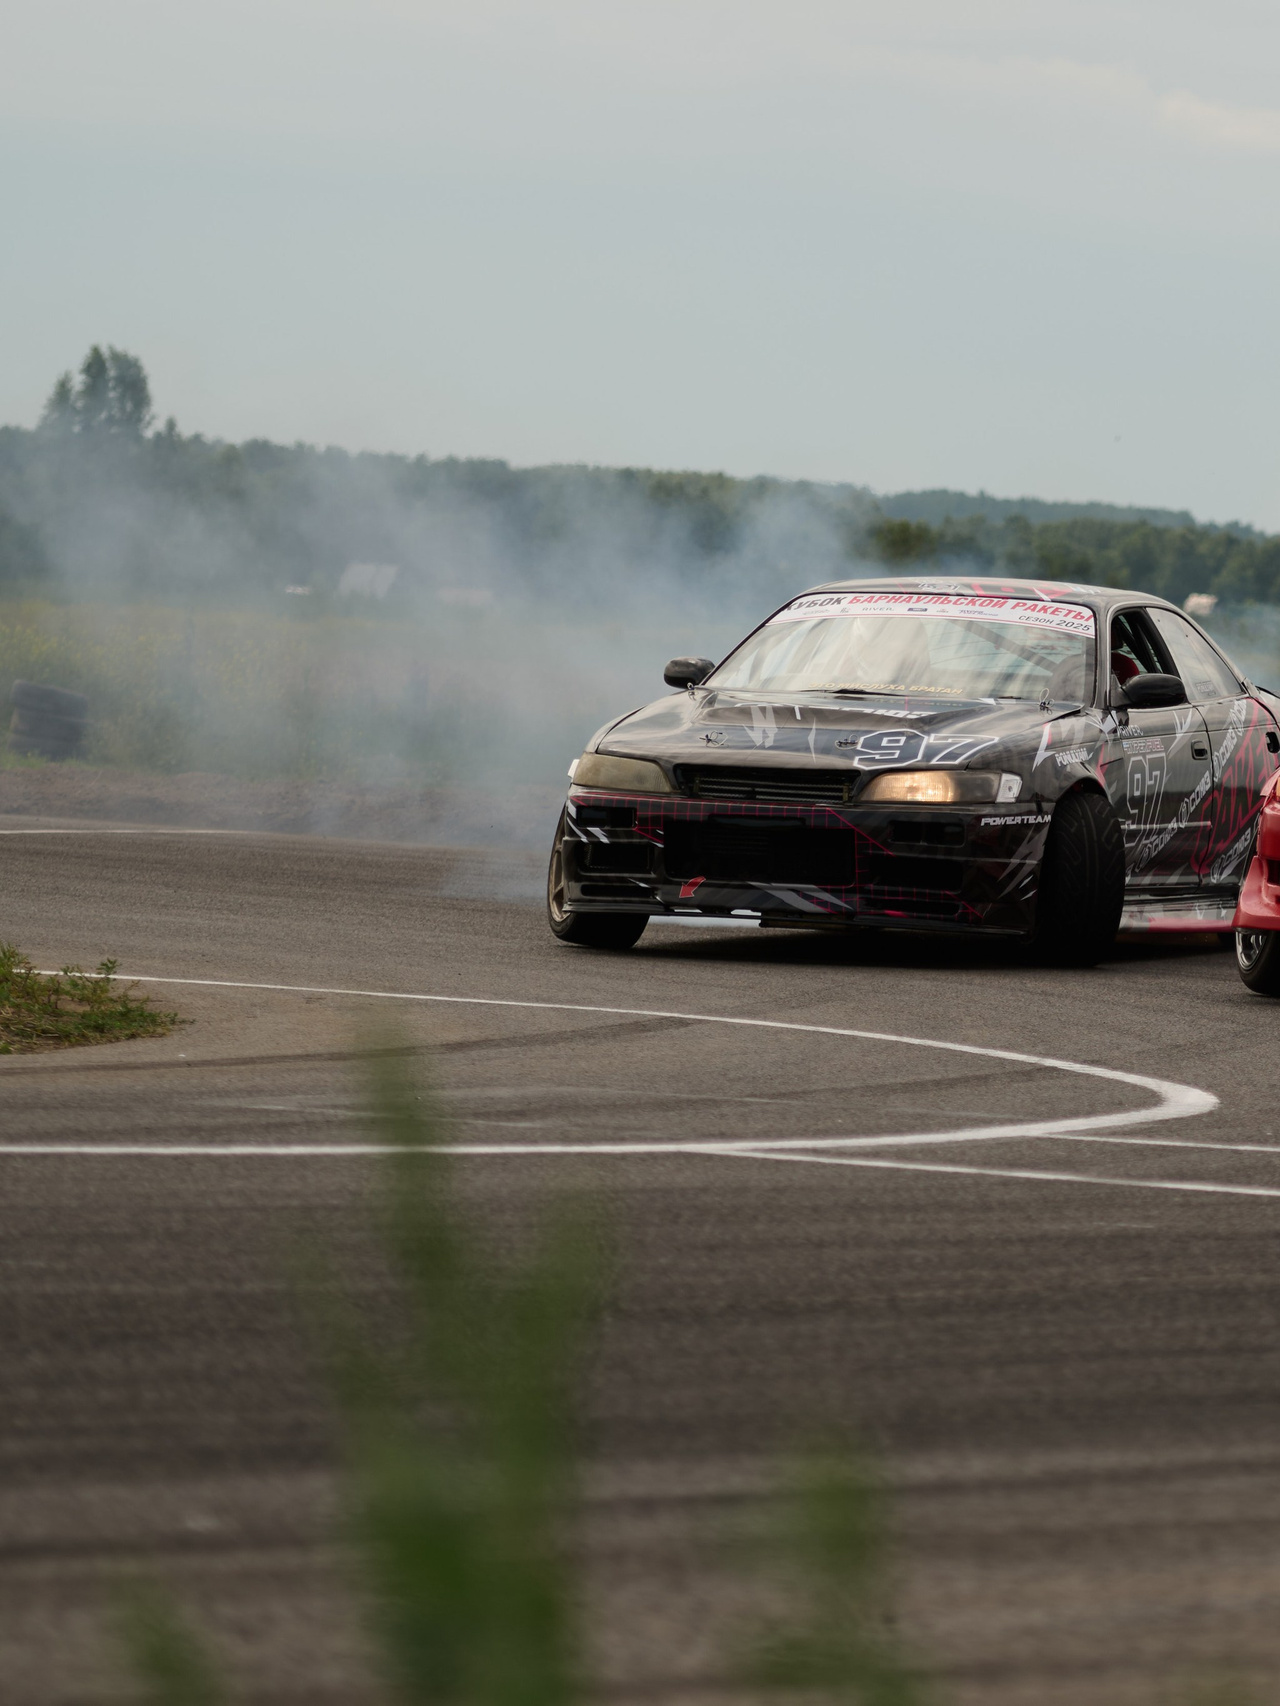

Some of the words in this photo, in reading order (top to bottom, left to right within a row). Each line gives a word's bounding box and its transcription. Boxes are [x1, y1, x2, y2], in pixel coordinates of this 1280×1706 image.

[847, 595, 1009, 609] БАРНАУЛЬСКОЙ
[1010, 600, 1094, 622] РАКЕТЫ
[1018, 615, 1054, 625] СЕЗОН
[1055, 619, 1093, 632] 2025
[908, 685, 964, 695] БРАТАН
[852, 728, 1000, 771] 97
[1123, 752, 1167, 847] 97
[980, 814, 1052, 827] POWERTEAM
